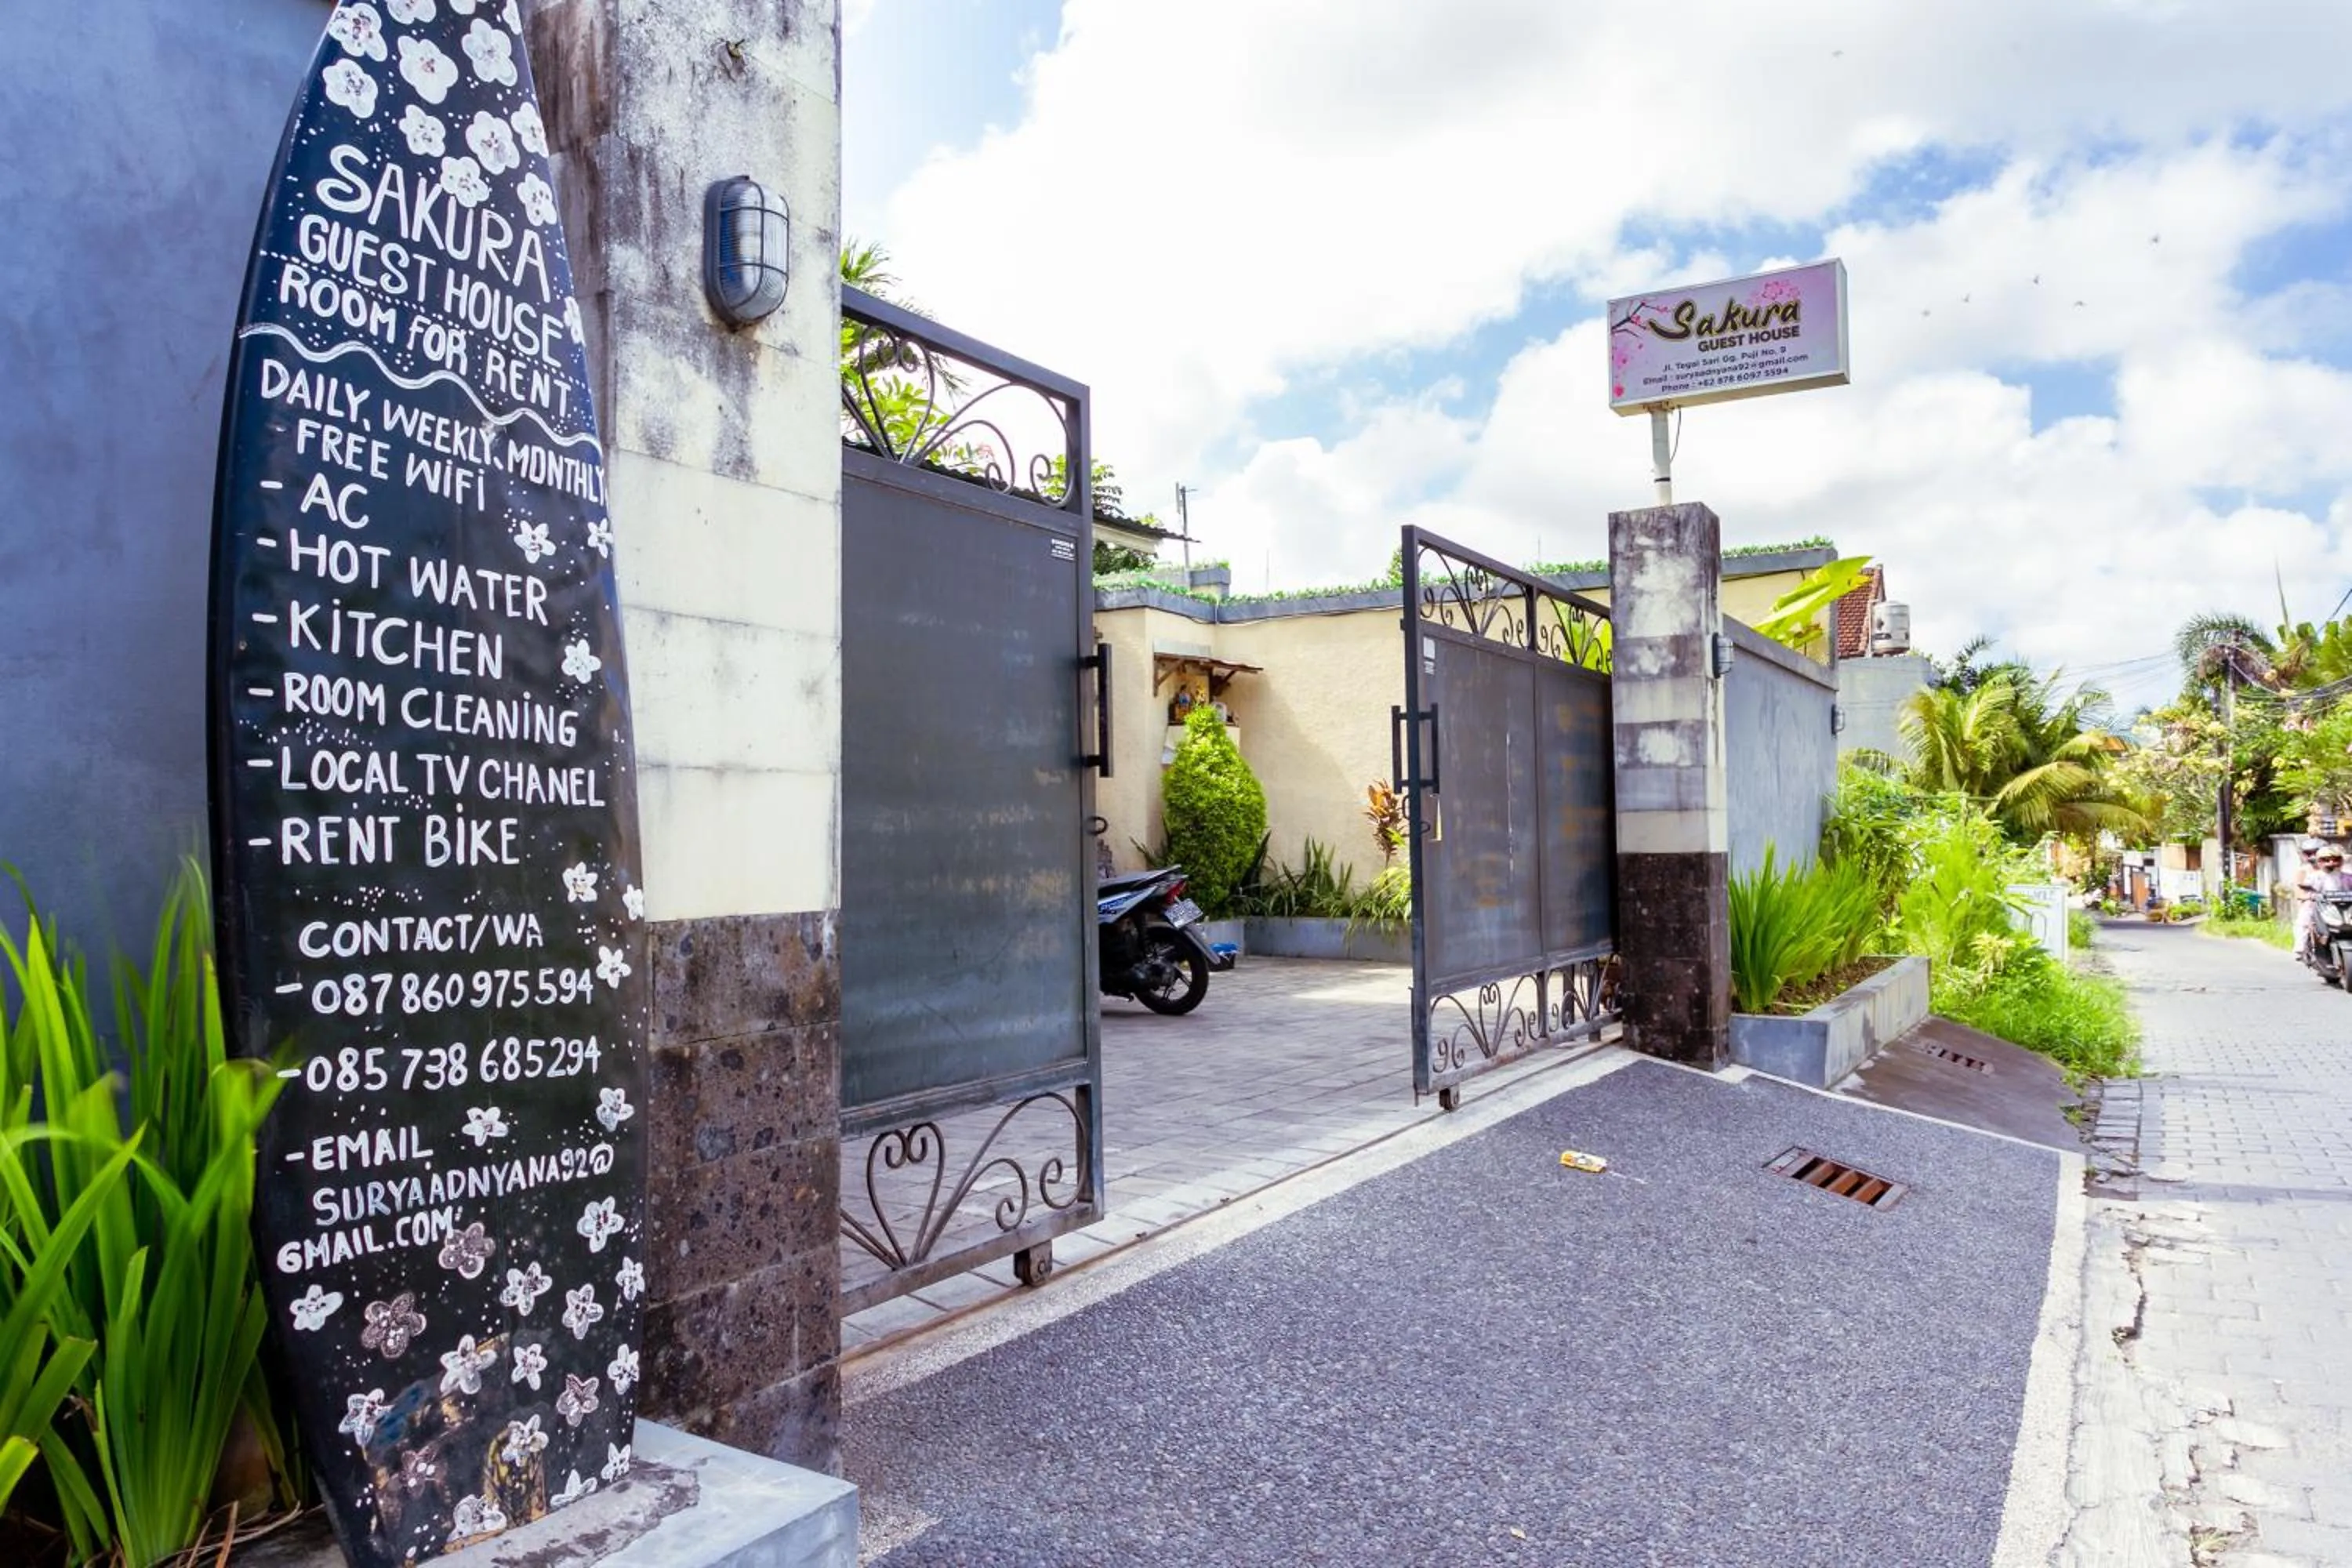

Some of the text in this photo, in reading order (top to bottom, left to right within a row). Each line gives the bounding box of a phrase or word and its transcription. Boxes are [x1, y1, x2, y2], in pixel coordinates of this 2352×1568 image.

[316, 144, 551, 303] SAKURA
[299, 215, 564, 368] GUEST HOUSE
[1648, 296, 1801, 339] Sakura
[279, 263, 572, 418] ROOM FOR RENT
[1698, 325, 1801, 352] GUEST HOUSE
[1702, 356, 1719, 366] Sari
[1741, 350, 1759, 359] Puji
[1643, 375, 1668, 385] Email
[1661, 383, 1690, 392] Phone
[1737, 371, 1762, 382] 6097
[297, 419, 391, 480] FREE
[506, 439, 604, 506] MONTHLY
[300, 473, 368, 528] AC
[290, 528, 390, 588] HOT
[411, 557, 548, 626] WATER
[284, 673, 385, 725] ROOM
[281, 746, 408, 793] LOCAL
[416, 753, 470, 795] TV
[479, 759, 605, 807] CHANEL
[282, 816, 400, 865] RENT
[299, 913, 543, 957] CONTACT/WA
[278, 1206, 454, 1272] GMAIL.COM
